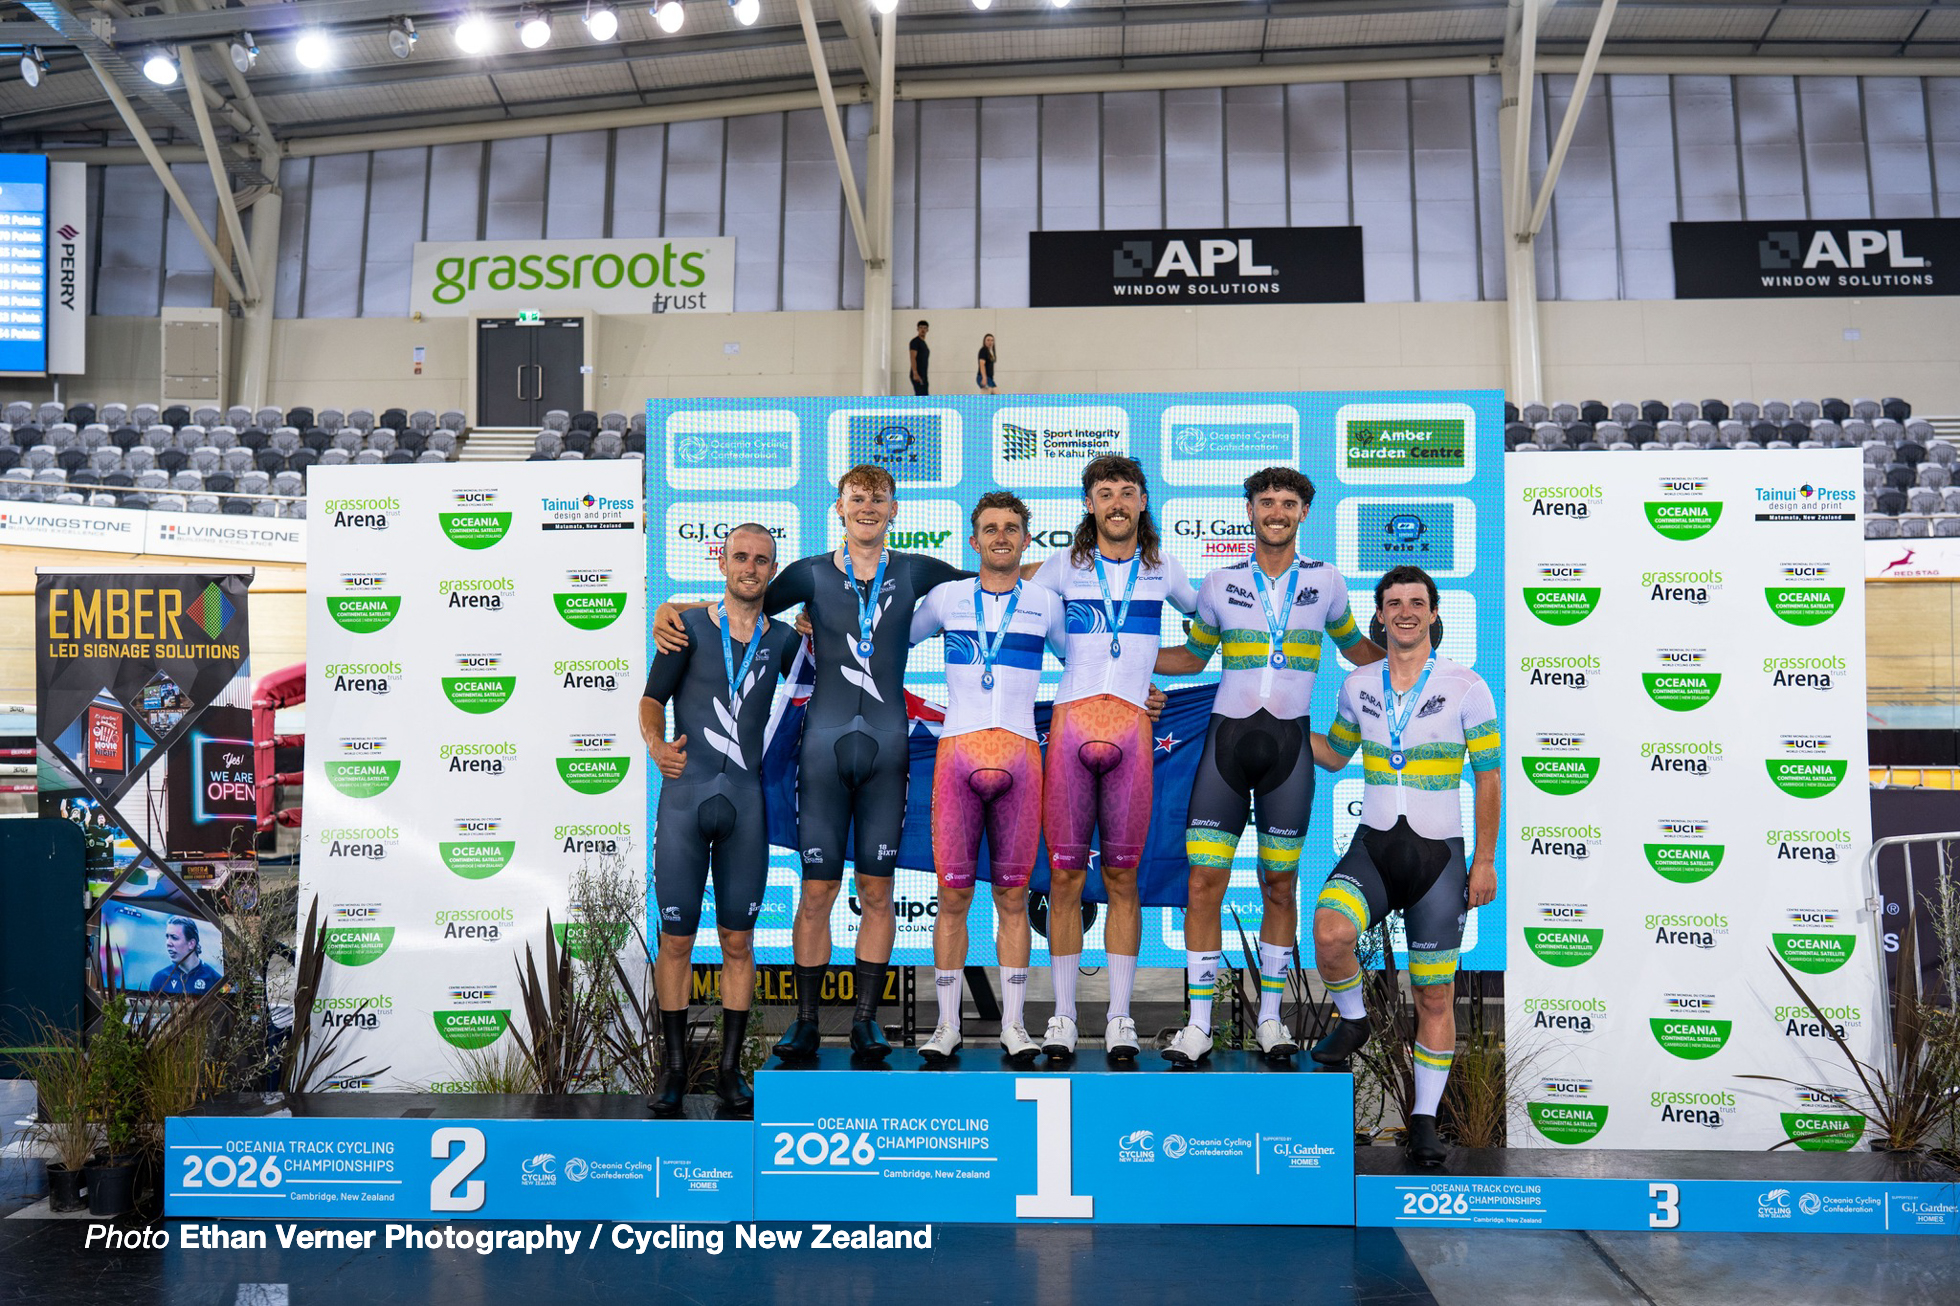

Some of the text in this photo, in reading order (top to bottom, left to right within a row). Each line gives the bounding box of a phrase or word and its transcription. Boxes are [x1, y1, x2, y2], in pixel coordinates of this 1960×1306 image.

[1802, 230, 1924, 269] APL
[1154, 239, 1272, 278] APL
[60, 243, 75, 311] PERRY
[432, 242, 706, 305] grassroots
[1761, 275, 1934, 287] WINDOW SOLUTIONS
[1114, 283, 1280, 295] WINDOW SOLUTIONS
[654, 291, 707, 310] trust
[1044, 429, 1120, 439] Sport Integrity
[1209, 430, 1289, 442] Oceania Cycling
[1379, 430, 1432, 442] Amber
[711, 440, 788, 450] Oceania Cycling
[1044, 439, 1109, 448] Commission
[1209, 442, 1278, 451] Confederation
[711, 451, 778, 460] Confederation
[1044, 450, 1057, 458] Te
[1059, 449, 1085, 458] Kahu
[1349, 446, 1463, 459] Garden Centre
[874, 455, 902, 463] Velo
[1673, 482, 1694, 491] UCI
[466, 493, 485, 502] UCI
[1523, 484, 1603, 502] grassroots
[1755, 487, 1856, 501] Tainui Press
[325, 496, 400, 515] grassroots
[542, 497, 634, 512] Tainui Press
[1532, 499, 1588, 516] Arena
[1769, 501, 1842, 512] design and print
[554, 510, 621, 521] design and print
[1657, 507, 1709, 516] OCEANIA
[9, 514, 132, 532] LIVINGSTONE
[334, 512, 386, 528] Arena
[451, 518, 499, 527] OCEANIA
[177, 525, 300, 543] LIVINGSTONE
[679, 524, 708, 543] G.J.
[1175, 520, 1206, 539] G.J.
[1206, 543, 1255, 553] HOMES
[1384, 543, 1430, 552] Velo X
[1300, 560, 1324, 568] Santini
[1642, 569, 1723, 588] grassroots
[440, 576, 515, 595] grassroots
[1228, 597, 1253, 608] Santini
[1536, 592, 1587, 603] OCEANIA
[1778, 592, 1831, 603] OCEANIA
[339, 601, 388, 611] OCEANIA
[50, 589, 183, 640] EMBER
[50, 644, 240, 659] LED SIGNAGE SOLUTIONS
[440, 741, 517, 759] grassroots
[223, 753, 244, 769] Yes!
[449, 756, 502, 772] Arena
[1535, 761, 1586, 772] OCEANIA
[210, 771, 253, 783] WE ARE
[208, 784, 255, 801] OPEN
[1191, 818, 1220, 828] Santini
[1268, 826, 1298, 836] Santini
[1332, 872, 1364, 887] Santini
[1645, 912, 1729, 930] grassroots
[444, 922, 499, 939] Arena
[1655, 927, 1714, 945] Arena
[330, 933, 381, 943] OCEANIA
[1412, 941, 1438, 950] Santini
[1787, 939, 1842, 950] OCEANIA
[1664, 1024, 1718, 1036] OCEANIA
[1651, 1090, 1736, 1108] grassroots
[1661, 1104, 1721, 1125] Arena
[817, 1118, 989, 1132] OCEANIA TRACK CYCLING
[226, 1141, 394, 1154] OCEANIA TRACK CYCLING
[774, 1132, 990, 1166] 2026 CHAMPIONSHIPS
[1015, 1078, 1094, 1218] 1
[1189, 1138, 1252, 1148] Oceania Cycling
[1119, 1151, 1155, 1159] CYCLING
[1189, 1147, 1243, 1156] Confederation
[1274, 1144, 1335, 1156] G.J. Gardner.
[590, 1161, 652, 1172] Oceania Cycling
[1291, 1158, 1319, 1166] HOMES
[183, 1155, 394, 1188] 2026 CHAMPIONSHIPS
[430, 1127, 486, 1212] 2
[590, 1171, 644, 1180] Confederation
[674, 1168, 733, 1180] G.J. Gardner.
[883, 1169, 990, 1180] Cambridge, New Zealand
[522, 1174, 557, 1182] CYCLING
[690, 1182, 717, 1190] HOMES
[1431, 1184, 1541, 1194] OCEANIA TRACK CYCLING
[290, 1192, 395, 1202] Cambridge, New Zealand
[1855, 1197, 1881, 1206] Cycling
[1403, 1193, 1542, 1214] 2026 CHAMPIONSHIPS
[1649, 1183, 1680, 1229] 3
[1823, 1205, 1874, 1213] Confederation
[1902, 1203, 1959, 1213] G.J. Gardner.
[1473, 1216, 1505, 1224] Cambridge,
